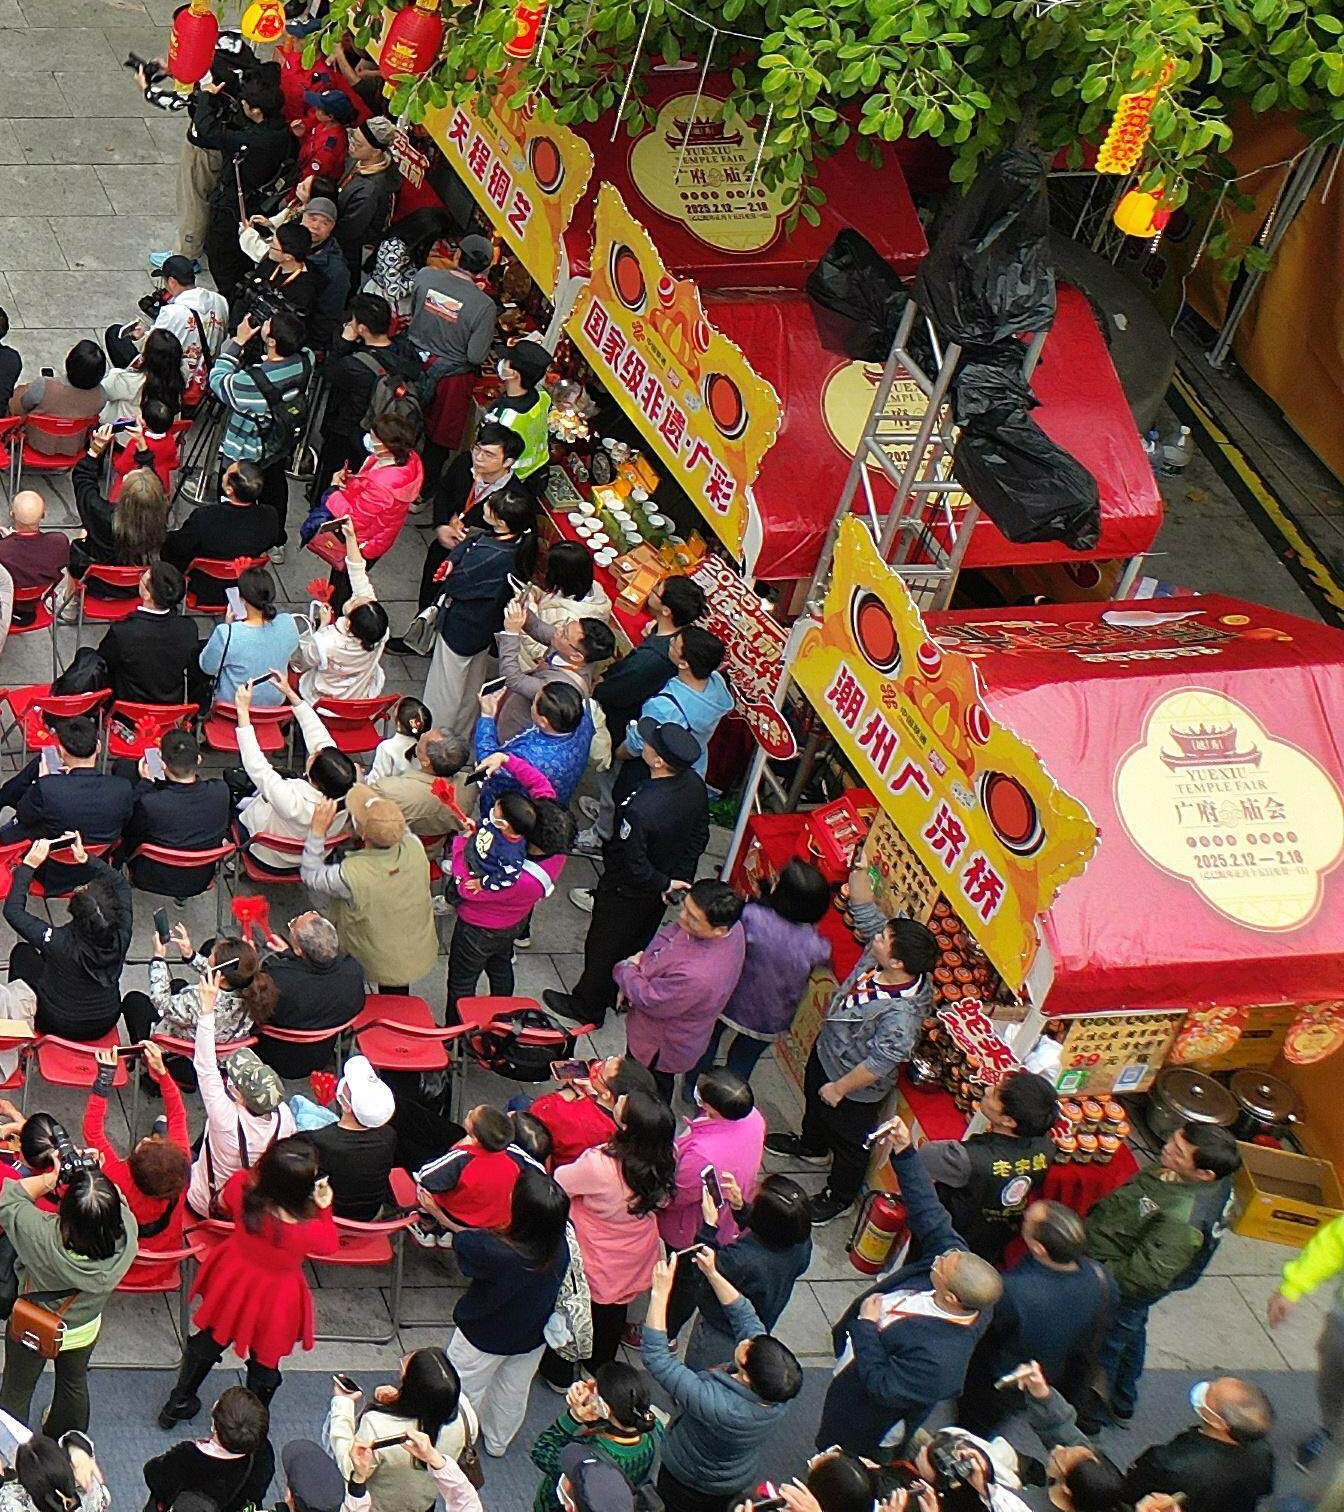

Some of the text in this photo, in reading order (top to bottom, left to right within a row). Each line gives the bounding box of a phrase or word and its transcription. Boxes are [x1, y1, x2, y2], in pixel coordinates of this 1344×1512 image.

[685, 146, 732, 155] YUEXIU
[722, 155, 746, 163] FAIR
[448, 110, 532, 237] 天程铜艺
[583, 299, 737, 513] 国家级非遗·广彩
[705, 557, 759, 611] 2025
[1186, 767, 1246, 782] YUEXIU
[825, 666, 1005, 920] 潮州广济桥
[1176, 780, 1268, 794] TEMPLE FAIR
[1174, 797, 1286, 825] 广府庙会
[1069, 1053, 1100, 1067] 39
